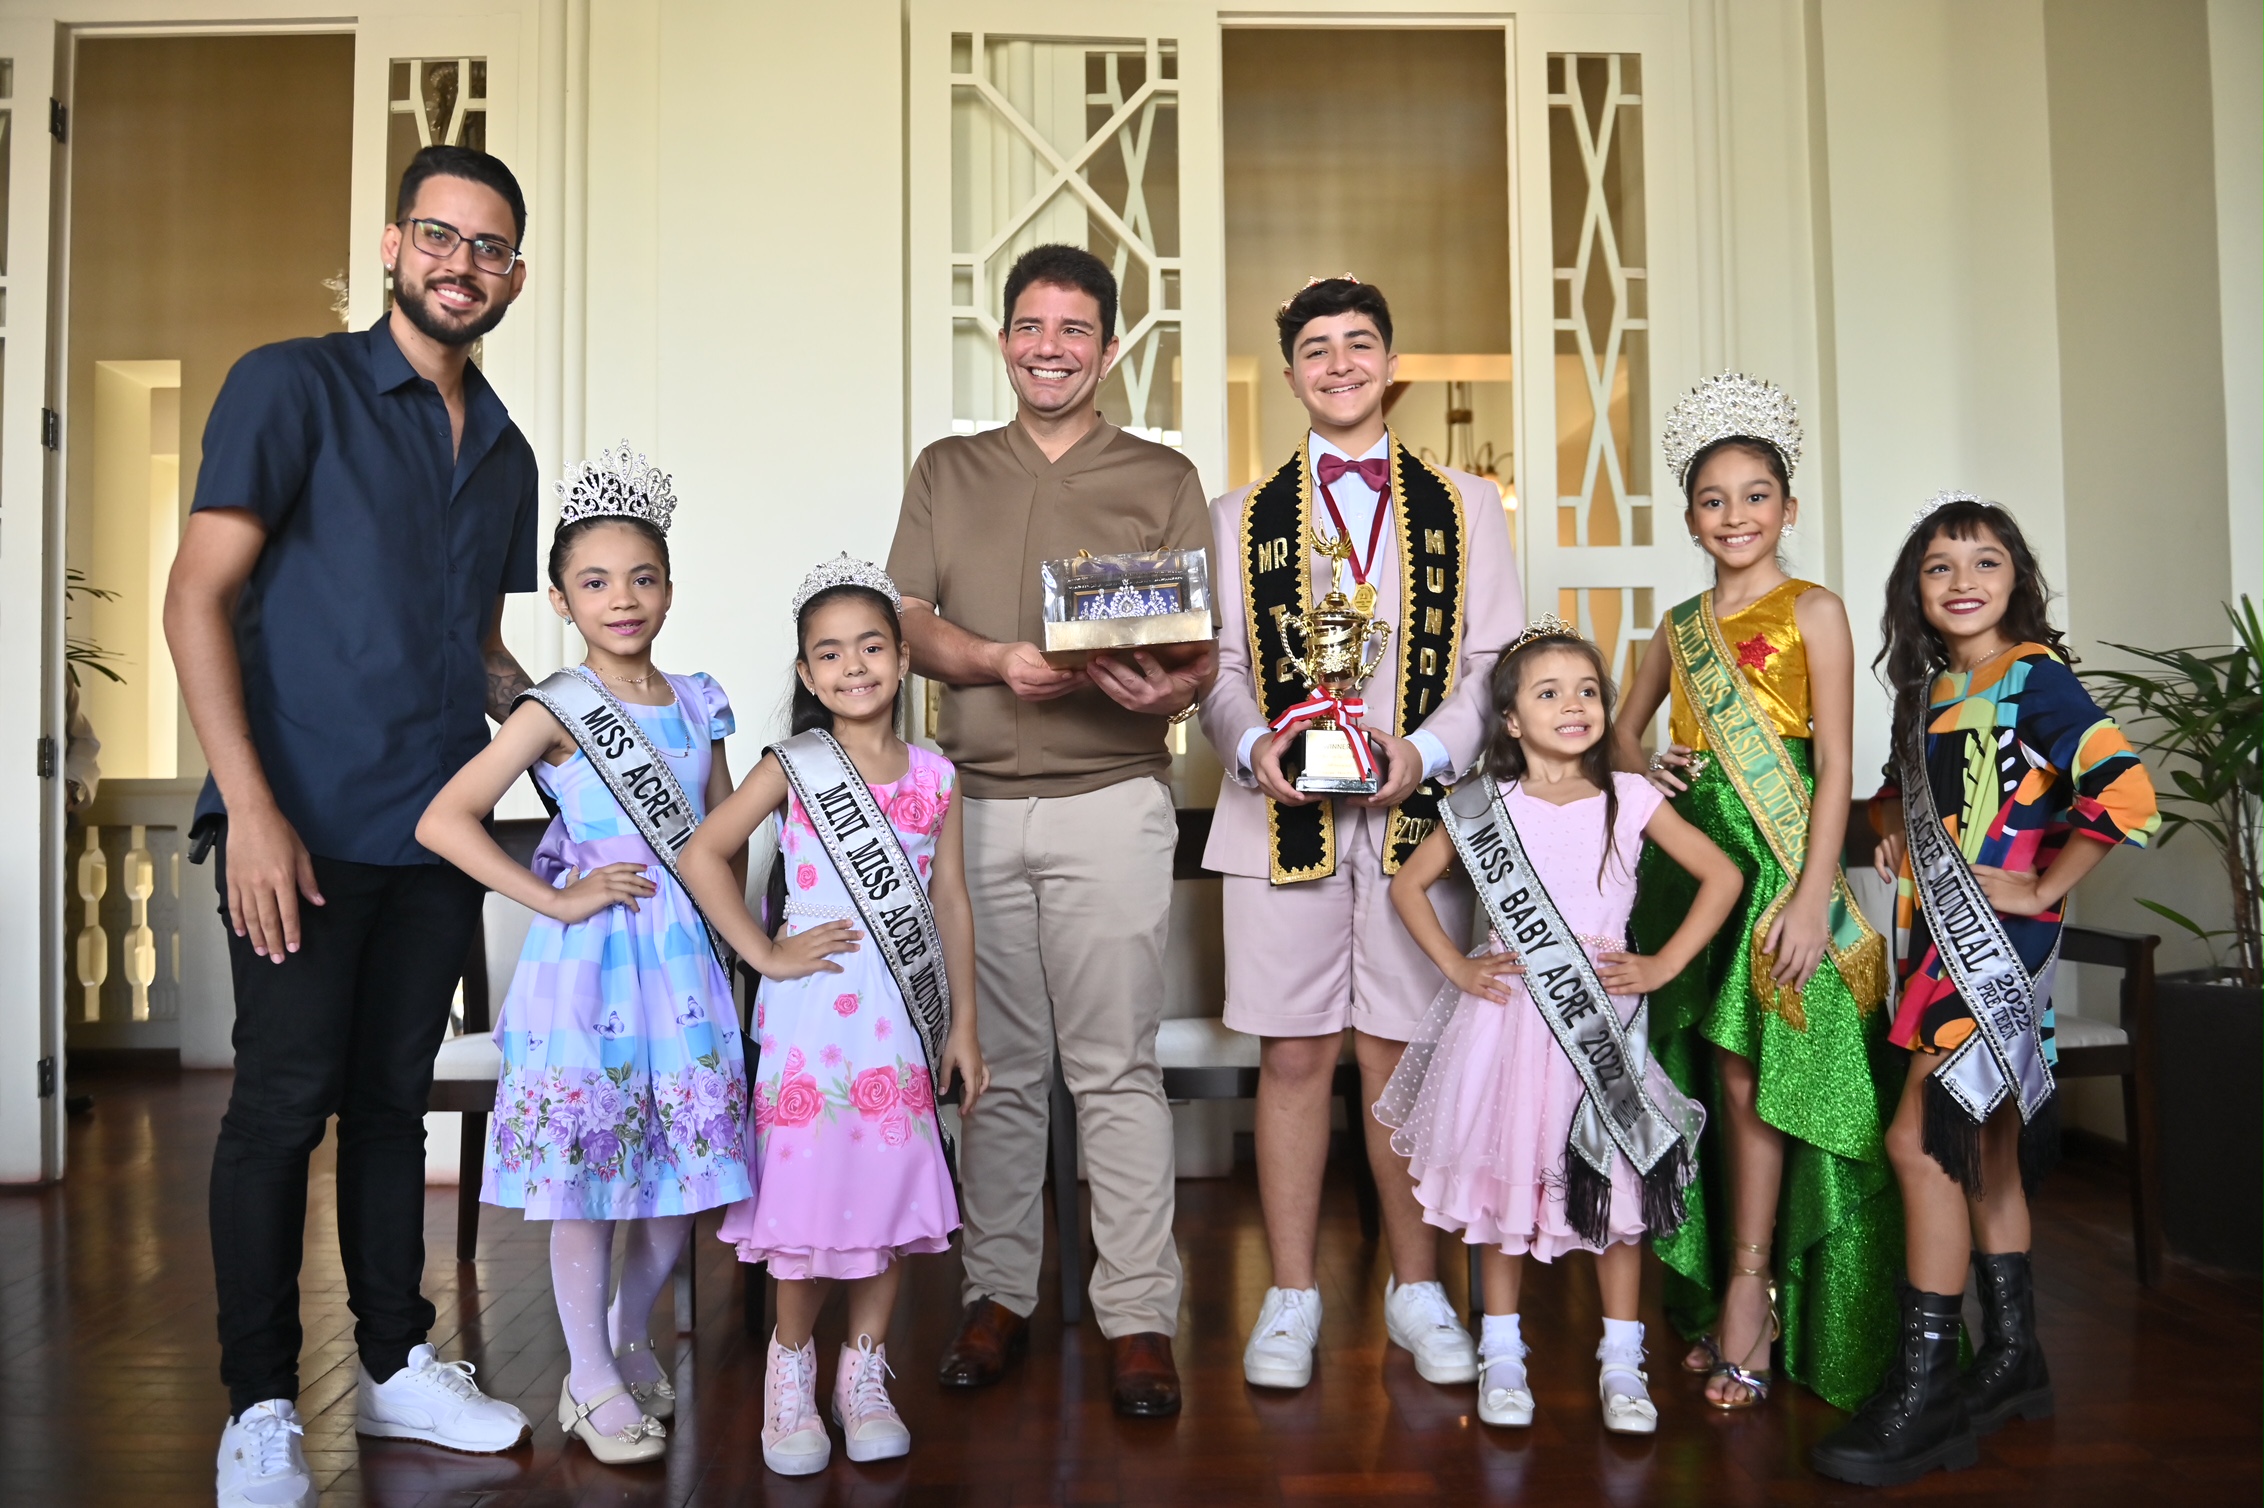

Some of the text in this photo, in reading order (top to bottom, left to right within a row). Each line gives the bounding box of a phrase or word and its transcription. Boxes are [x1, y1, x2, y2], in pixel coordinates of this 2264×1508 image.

[1257, 536, 1289, 574] MR
[580, 705, 635, 760] MISS
[621, 762, 681, 829] ACRE
[1690, 657, 1732, 708] MISS
[1712, 700, 1770, 771] BRASIL
[814, 781, 871, 842] MINI
[846, 837, 901, 900] MISS
[879, 904, 928, 967] ACRE
[1396, 815, 1438, 845] 202
[1466, 821, 1625, 1092] MISS BABY ACRE 2022
[1911, 810, 1943, 869] ACRE
[1928, 865, 2000, 974] MUNDIAL
[1994, 973, 2032, 1032] 2022
[1976, 980, 2019, 1042] PRE TEEN
